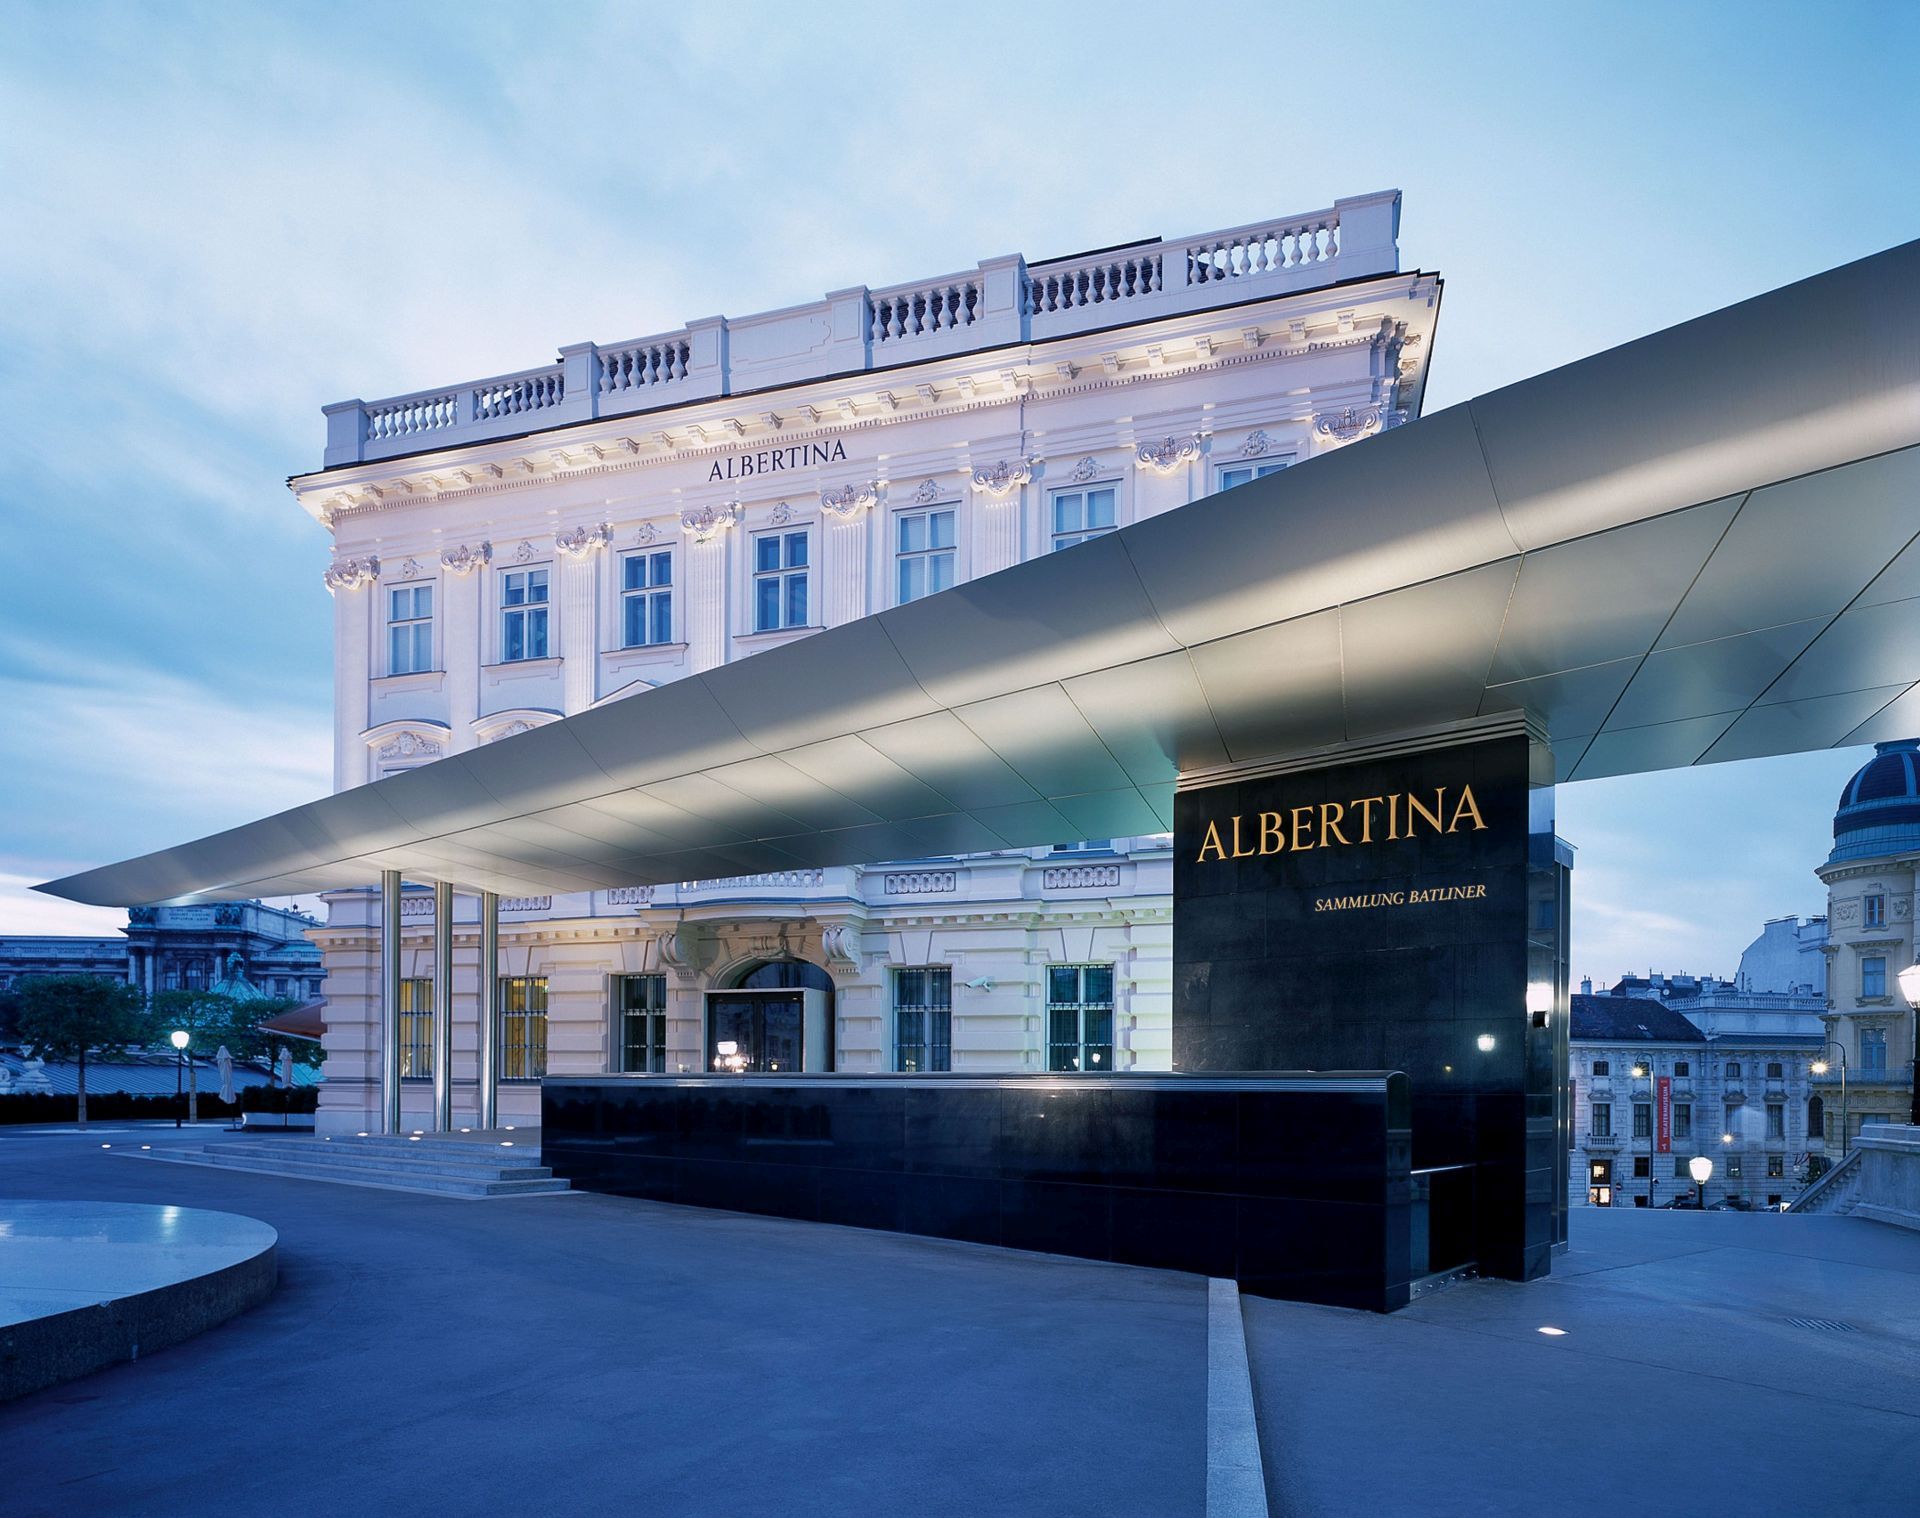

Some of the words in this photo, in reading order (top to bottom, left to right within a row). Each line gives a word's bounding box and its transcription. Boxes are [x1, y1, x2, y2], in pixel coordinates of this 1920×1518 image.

[708, 439, 847, 482] ALBERTINA
[1195, 784, 1488, 863] ALBERTINA
[1315, 892, 1404, 912] SAMMLUNG
[1409, 885, 1487, 904] BATLINER
